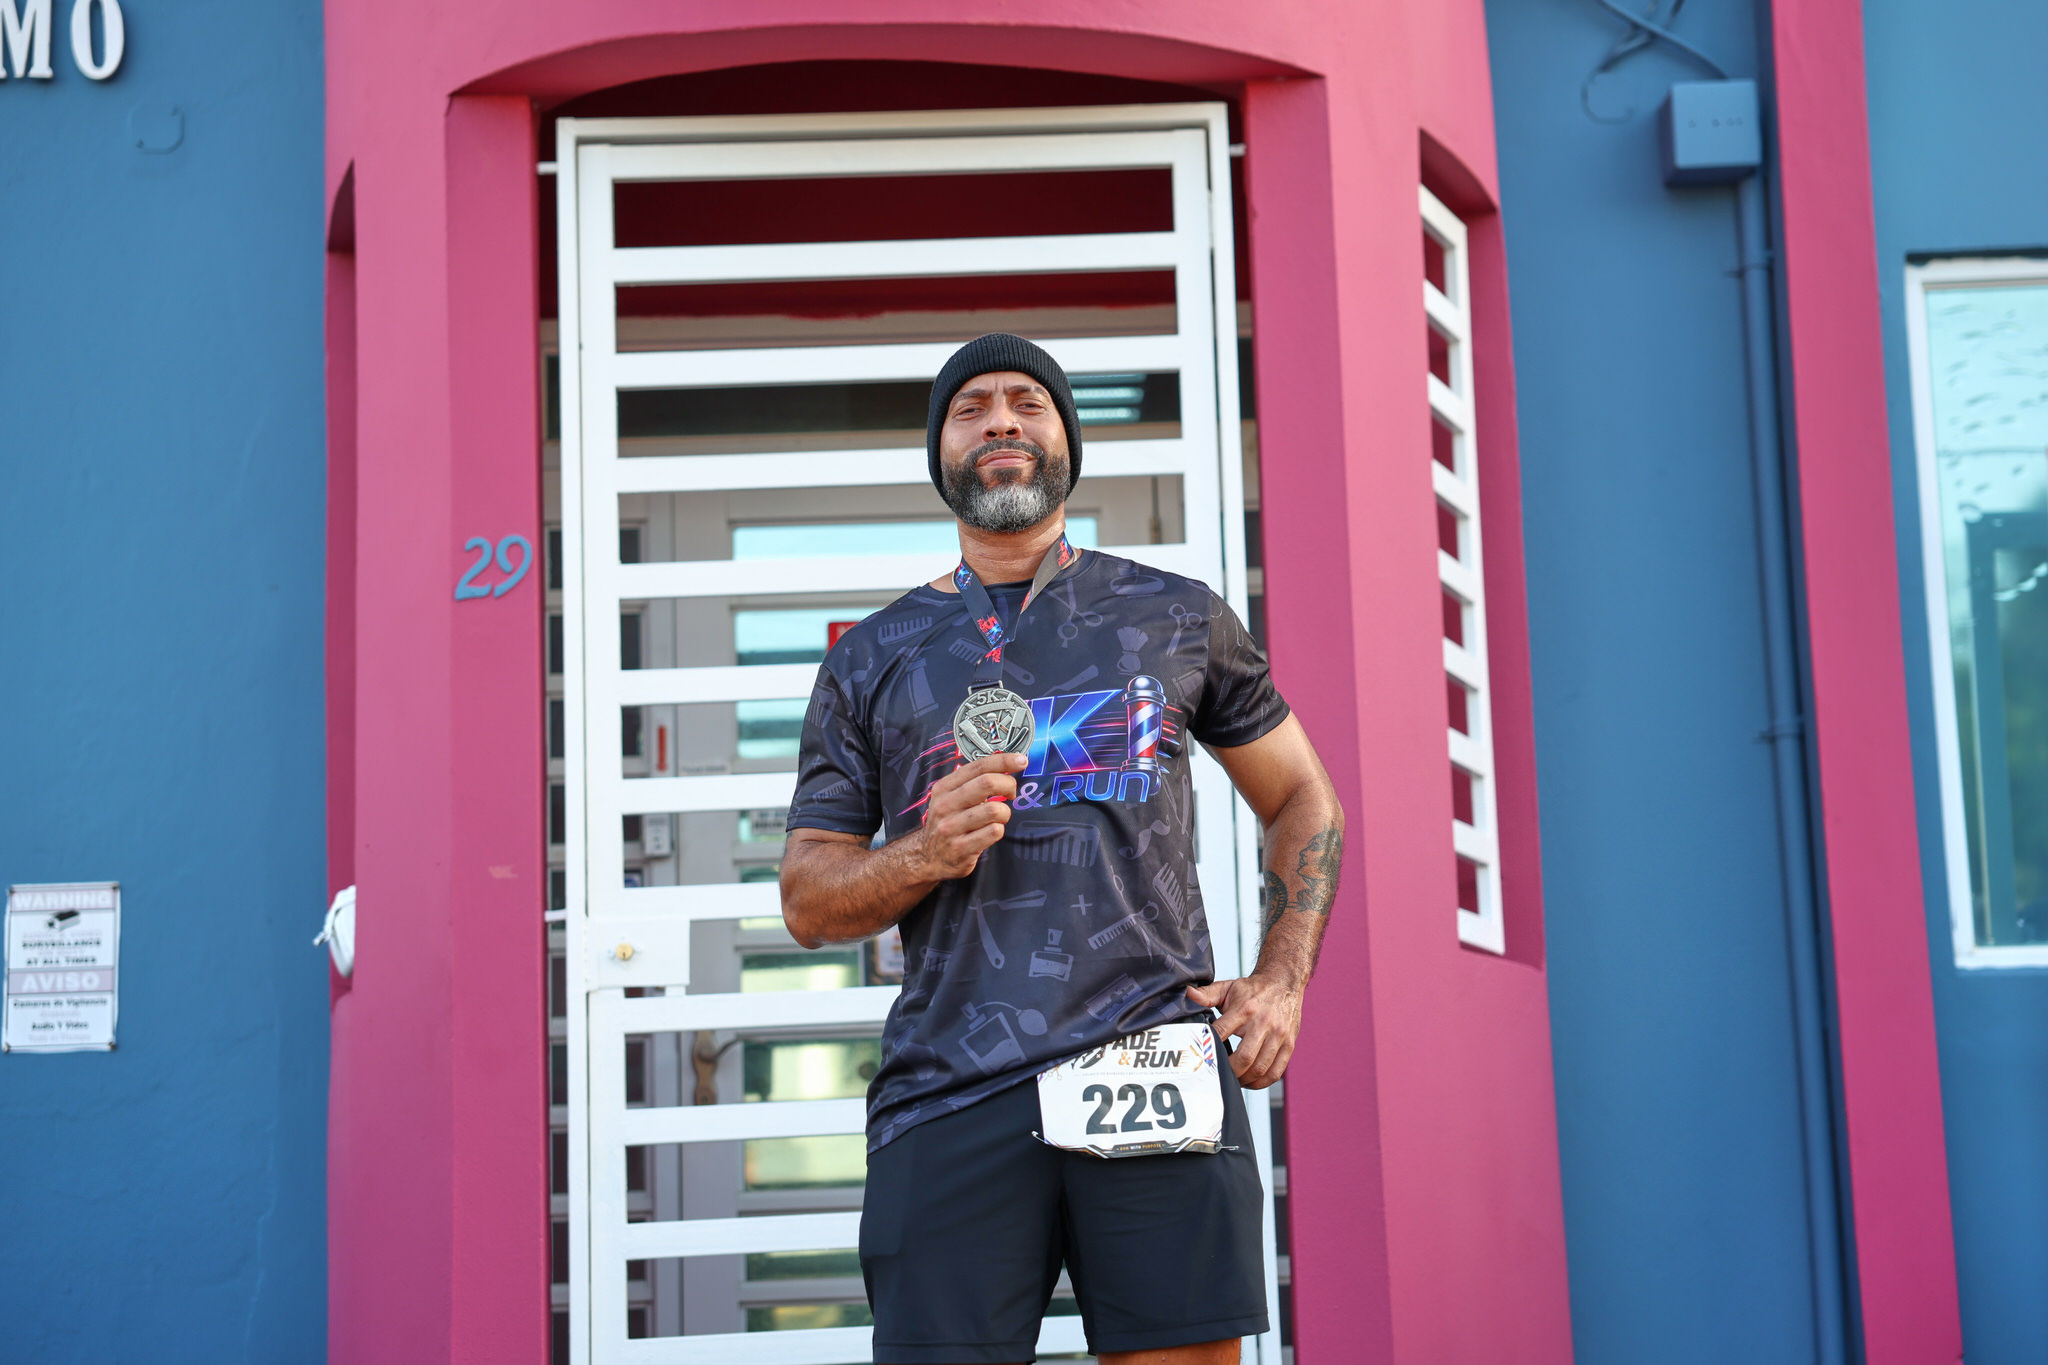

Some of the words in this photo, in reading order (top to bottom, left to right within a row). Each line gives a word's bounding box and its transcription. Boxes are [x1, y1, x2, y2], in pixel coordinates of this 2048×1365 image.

[455, 535, 533, 600] 29
[976, 690, 1000, 705] 5K
[1012, 782, 1044, 811] &
[1050, 771, 1150, 806] RUN
[14, 891, 110, 911] WARNING
[22, 971, 100, 992] AVISO
[1108, 1031, 1160, 1050] ADE
[1118, 1051, 1131, 1066] &
[1133, 1050, 1182, 1068] RUN
[1082, 1083, 1187, 1135] 229
